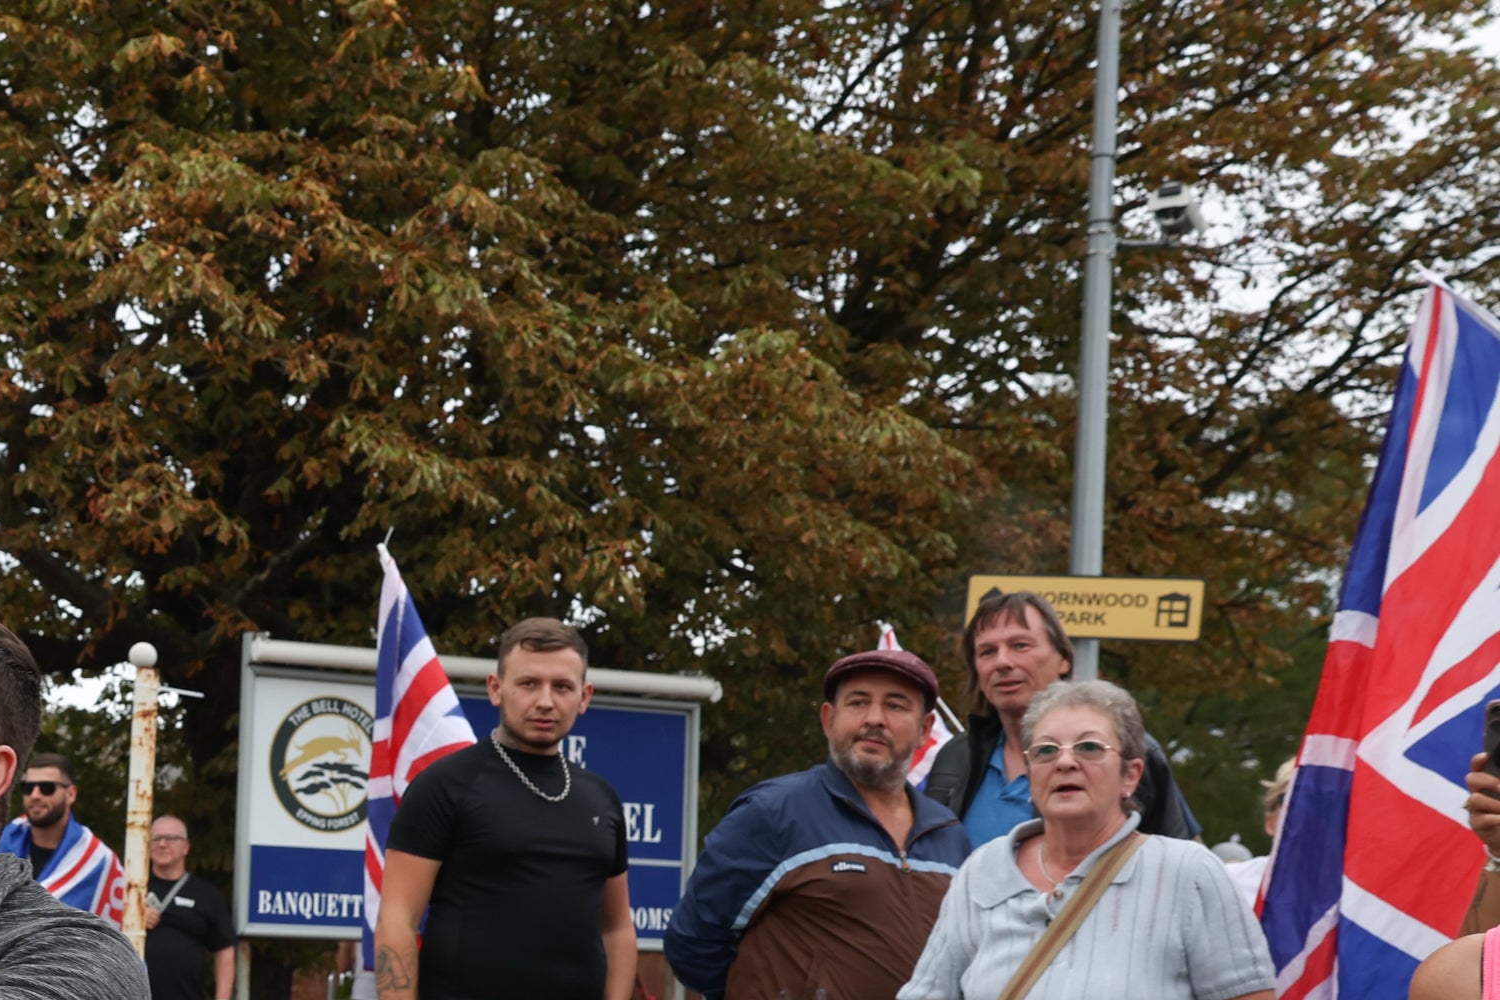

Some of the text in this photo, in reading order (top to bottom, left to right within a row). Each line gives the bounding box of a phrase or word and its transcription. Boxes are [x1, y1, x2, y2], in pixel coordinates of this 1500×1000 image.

[1041, 591, 1149, 608] ORNWOOD
[288, 699, 374, 734] THE BELL HOTEL
[295, 807, 360, 830] EPPING FOREST
[258, 889, 364, 920] BANQUETT
